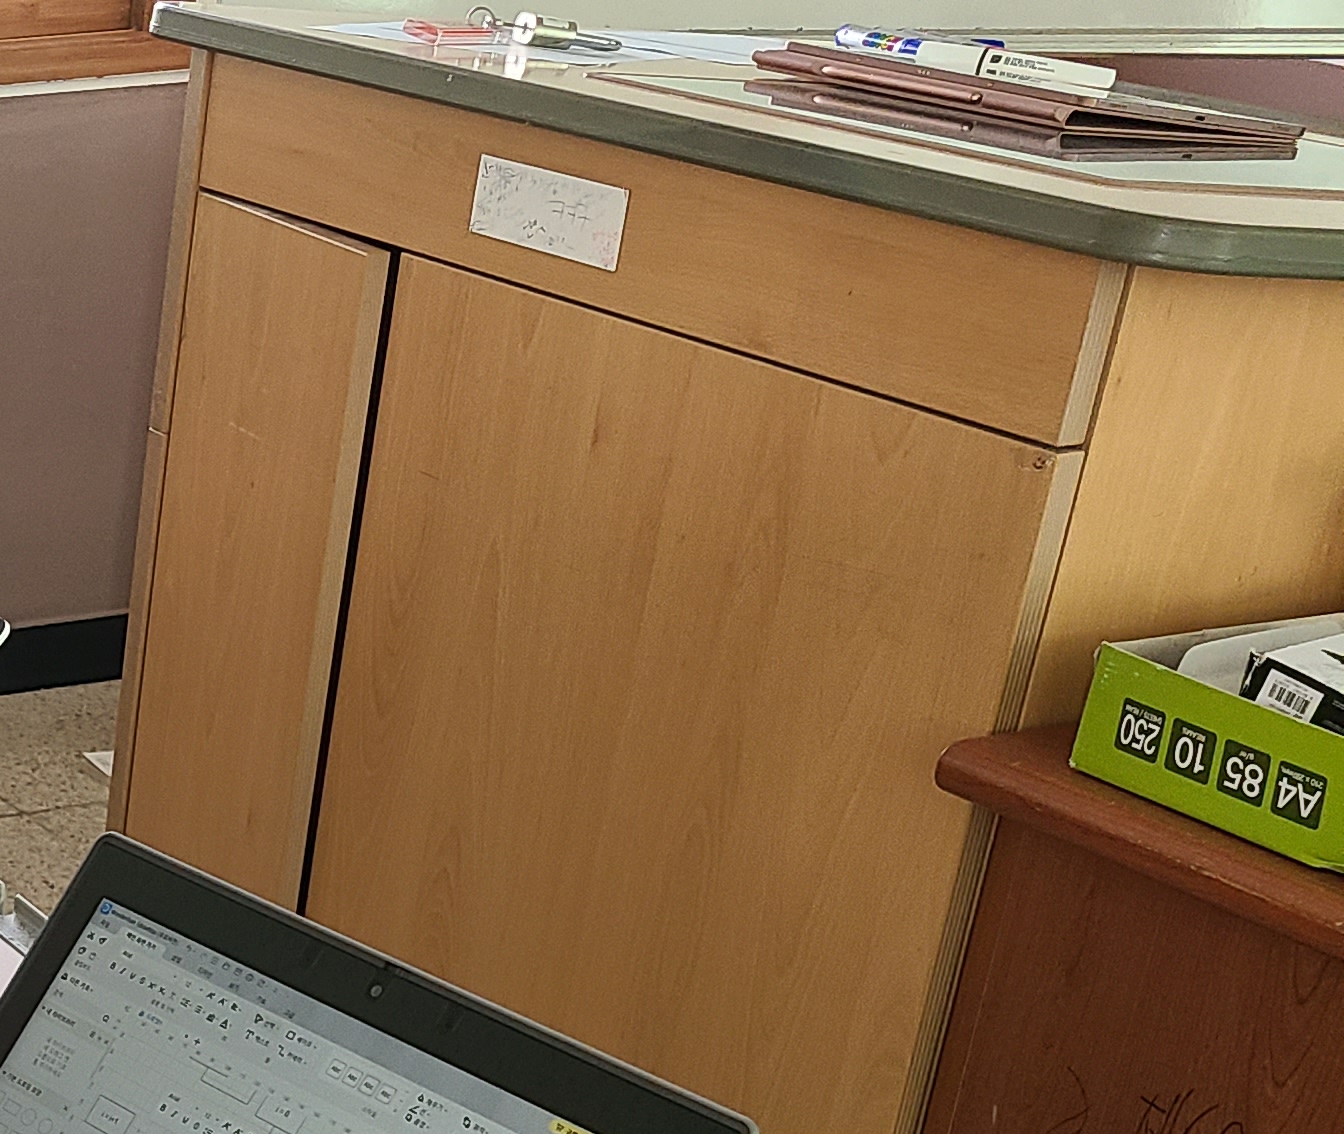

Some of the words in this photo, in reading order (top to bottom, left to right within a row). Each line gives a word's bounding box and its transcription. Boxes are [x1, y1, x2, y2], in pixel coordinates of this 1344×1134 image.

[1120, 713, 1161, 755] 250
[1174, 736, 1205, 774] 10
[1223, 756, 1264, 798] 85
[1276, 777, 1322, 819] A4
